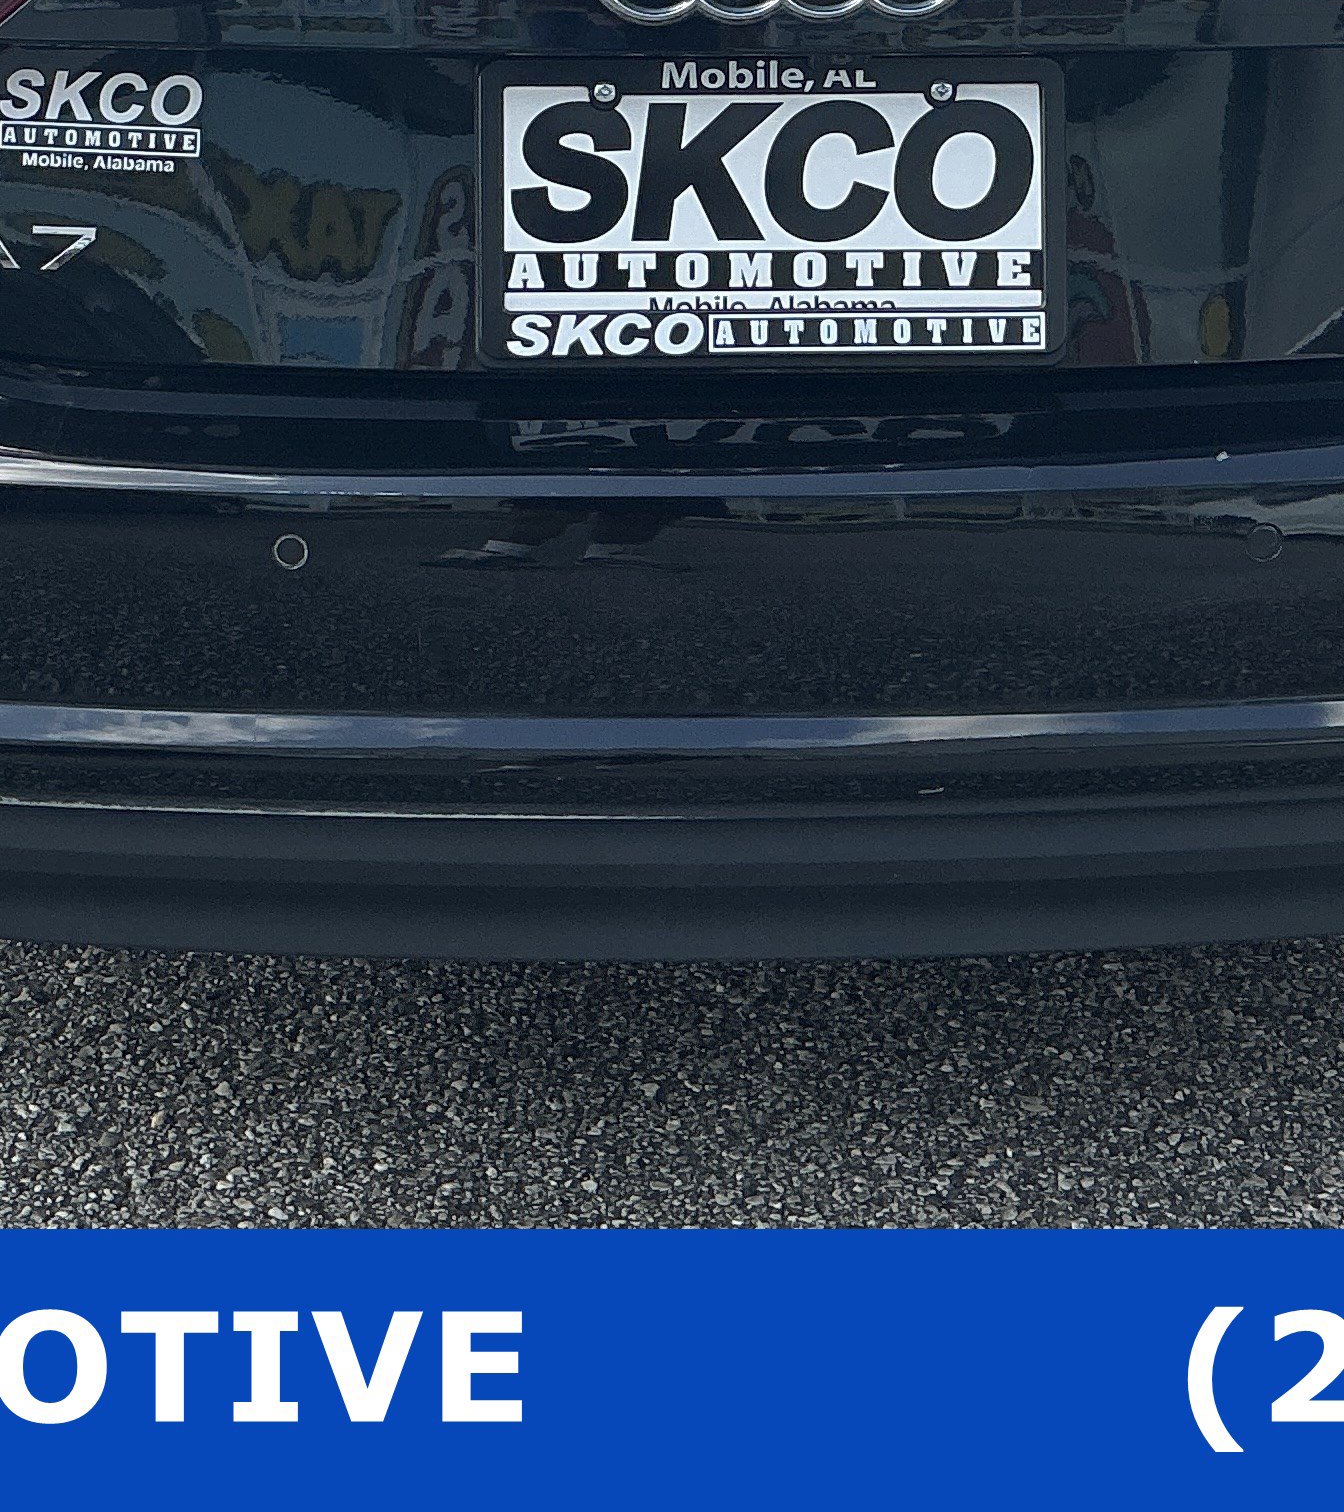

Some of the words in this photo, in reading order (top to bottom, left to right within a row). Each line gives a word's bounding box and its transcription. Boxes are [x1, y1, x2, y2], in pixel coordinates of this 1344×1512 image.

[661, 60, 815, 93] Mobile,
[823, 69, 877, 89] AL
[2, 126, 197, 152] AUTOMOTIVE
[21, 152, 89, 172] Mobile,
[93, 155, 175, 174] Alabama
[509, 98, 1035, 244] SKCO
[507, 251, 1032, 290] AUTOMOTIVE
[506, 313, 705, 357] SKCO
[714, 316, 1042, 347] AUTOMOTIVE
